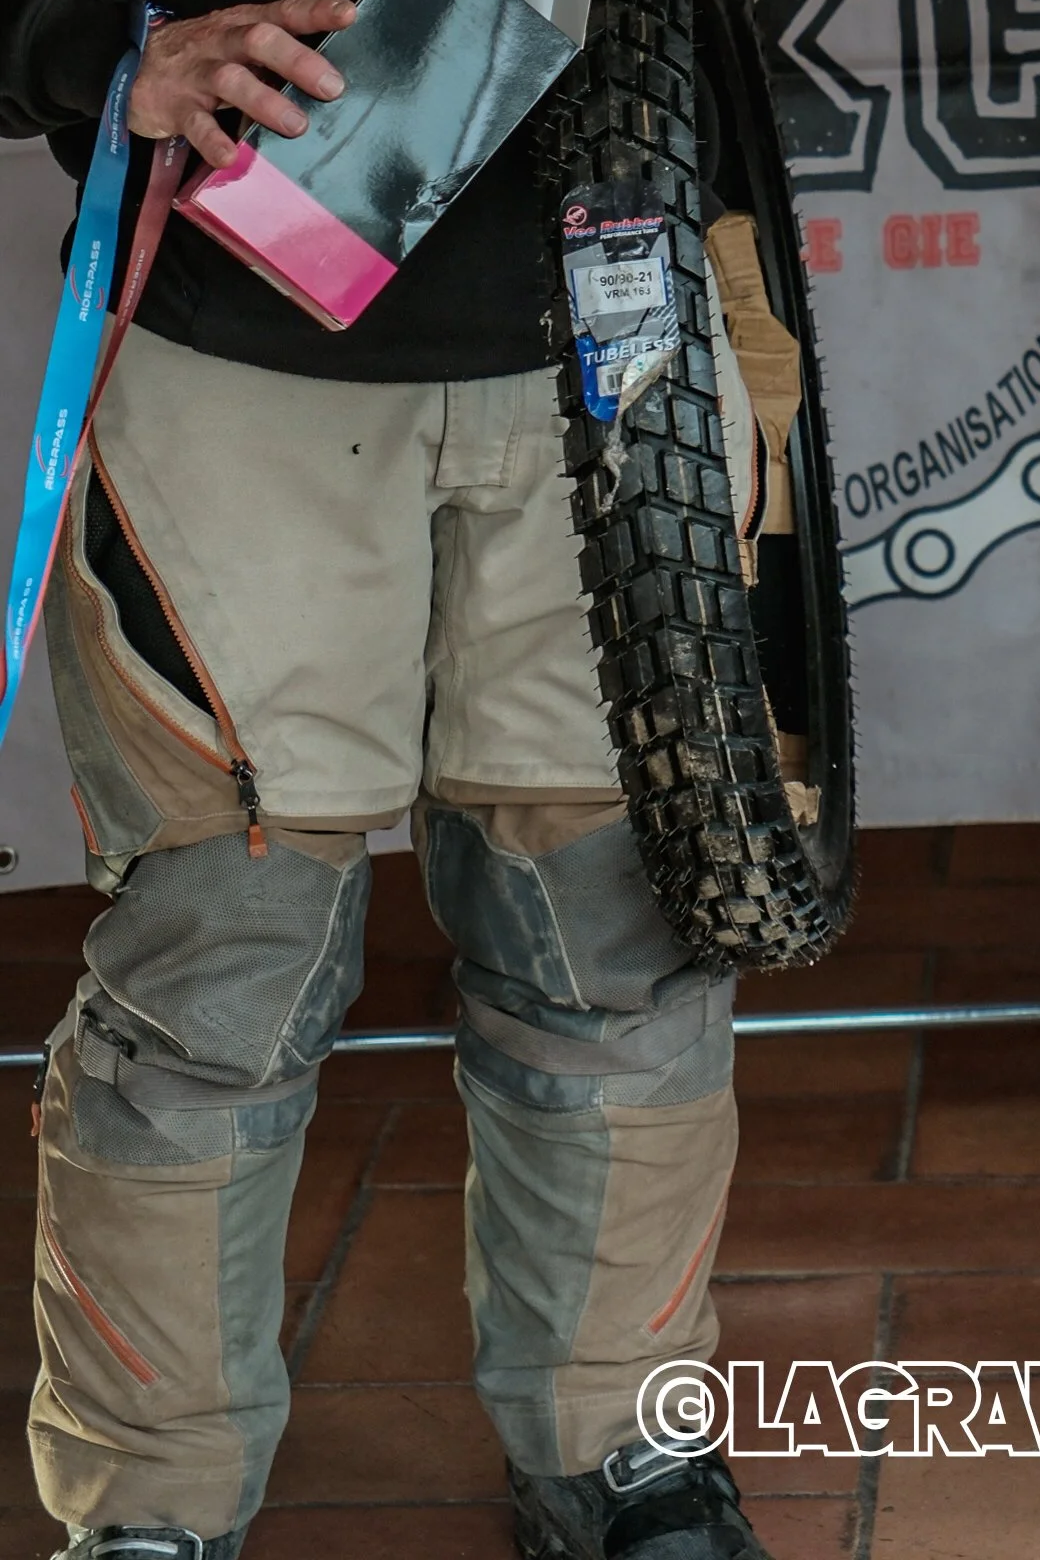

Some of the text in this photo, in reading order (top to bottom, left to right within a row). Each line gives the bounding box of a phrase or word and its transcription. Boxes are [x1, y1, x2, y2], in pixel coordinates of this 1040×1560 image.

[111, 72, 128, 155] RIDERPASS
[563, 217, 664, 240] Vee Rubber
[79, 239, 101, 323] RIDERPASS
[599, 271, 653, 287] 90/90-21
[604, 288, 630, 300] VRM
[583, 338, 676, 367] TUBELESS
[45, 407, 69, 492] RIDERPASS
